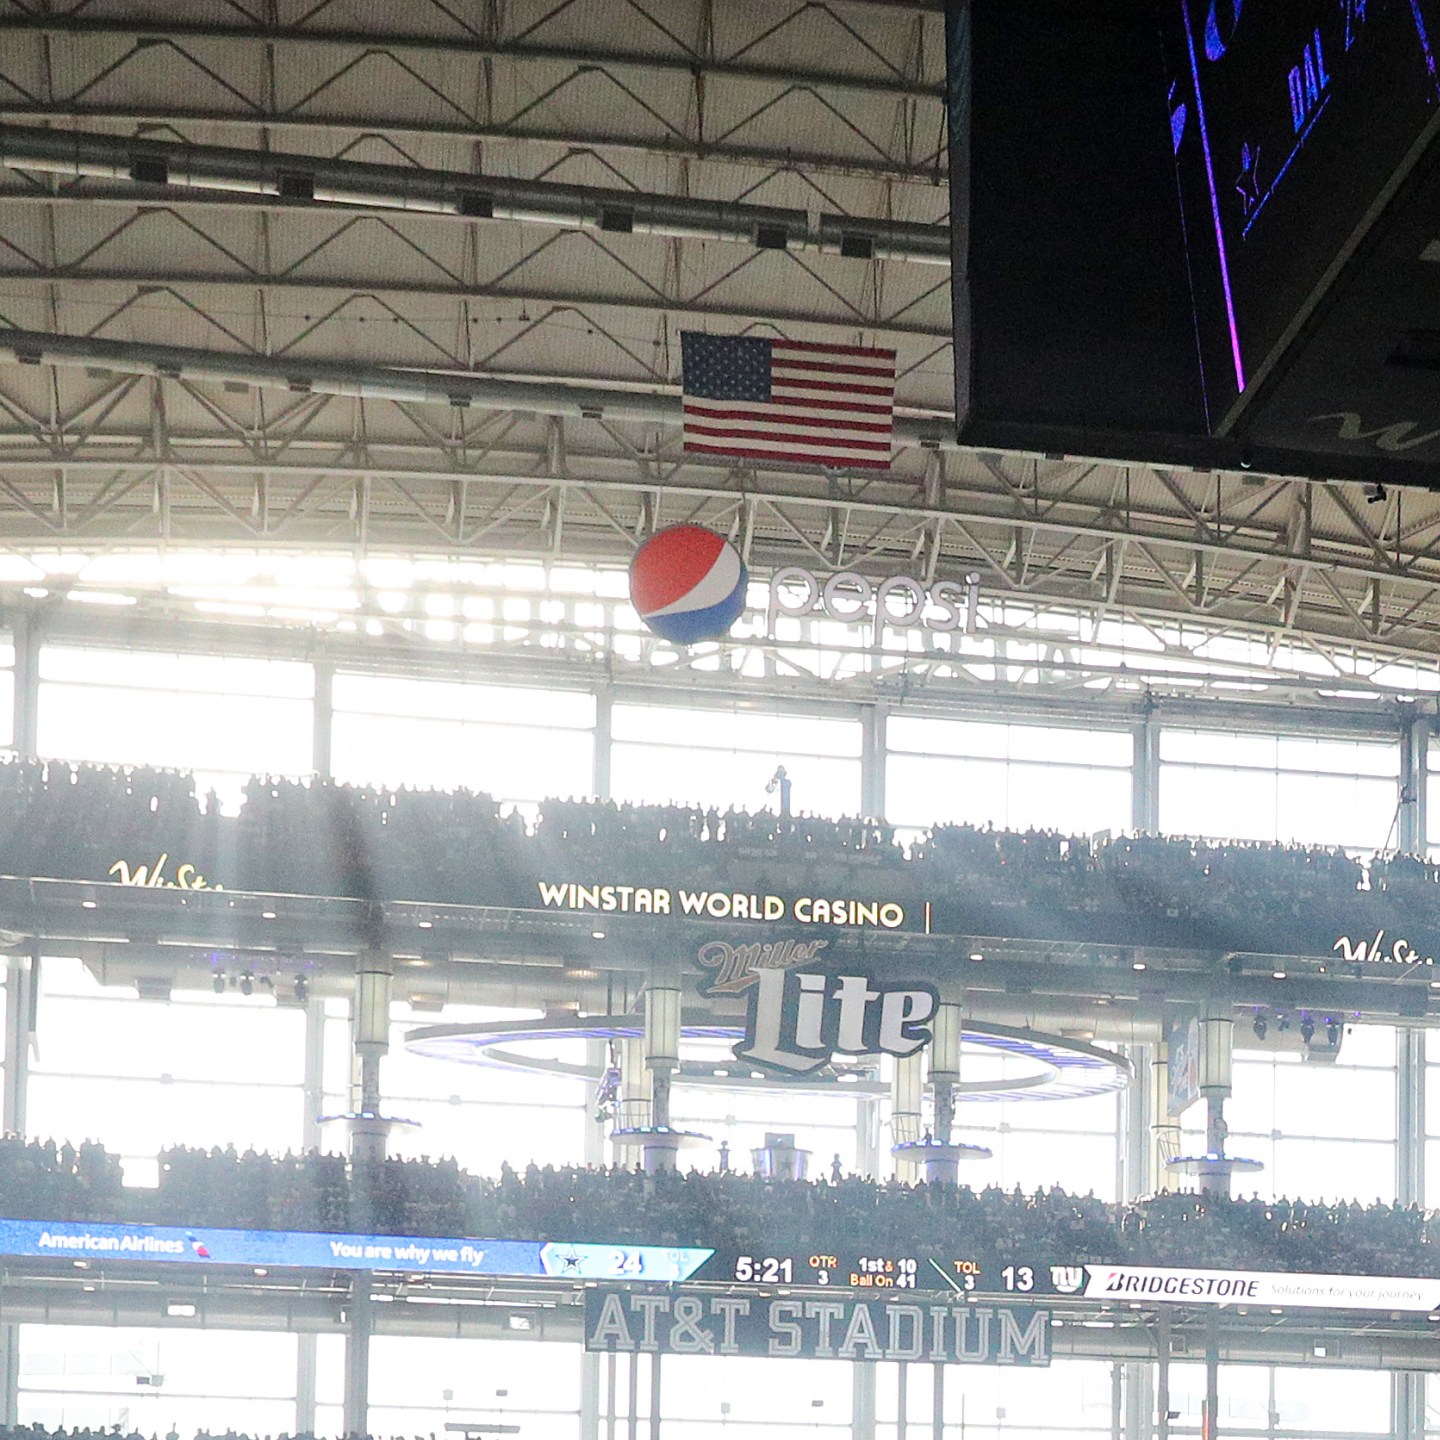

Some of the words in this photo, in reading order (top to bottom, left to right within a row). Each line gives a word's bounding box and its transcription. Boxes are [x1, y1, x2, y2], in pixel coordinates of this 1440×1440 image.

[767, 566, 981, 648] pepsi
[538, 881, 671, 915] WINSTAR
[679, 890, 785, 921] WORLD
[794, 897, 905, 929] CASINO
[698, 937, 829, 993] Miller
[734, 967, 934, 1073] Lite
[38, 1232, 119, 1251] American
[120, 1235, 185, 1254] Airlines
[330, 1241, 362, 1259] You
[365, 1246, 392, 1261] are
[394, 1243, 430, 1264] why
[432, 1249, 458, 1262] we
[460, 1248, 485, 1267] fly
[608, 1251, 643, 1276] 24
[735, 1256, 793, 1283] 5:21
[898, 1259, 917, 1274] 10
[954, 1260, 980, 1274] TOL
[818, 1270, 829, 1285] 3
[850, 1273, 874, 1288] Ball
[875, 1275, 894, 1288] On
[896, 1274, 916, 1289] 41
[964, 1275, 976, 1291] 3
[1001, 1265, 1035, 1291] 13
[1107, 1272, 1260, 1298] BRIDGESTONE
[1271, 1284, 1325, 1297] Solutions
[1329, 1286, 1347, 1297] for
[589, 1293, 750, 1355] AT&T
[768, 1301, 1050, 1366] STADIUM
